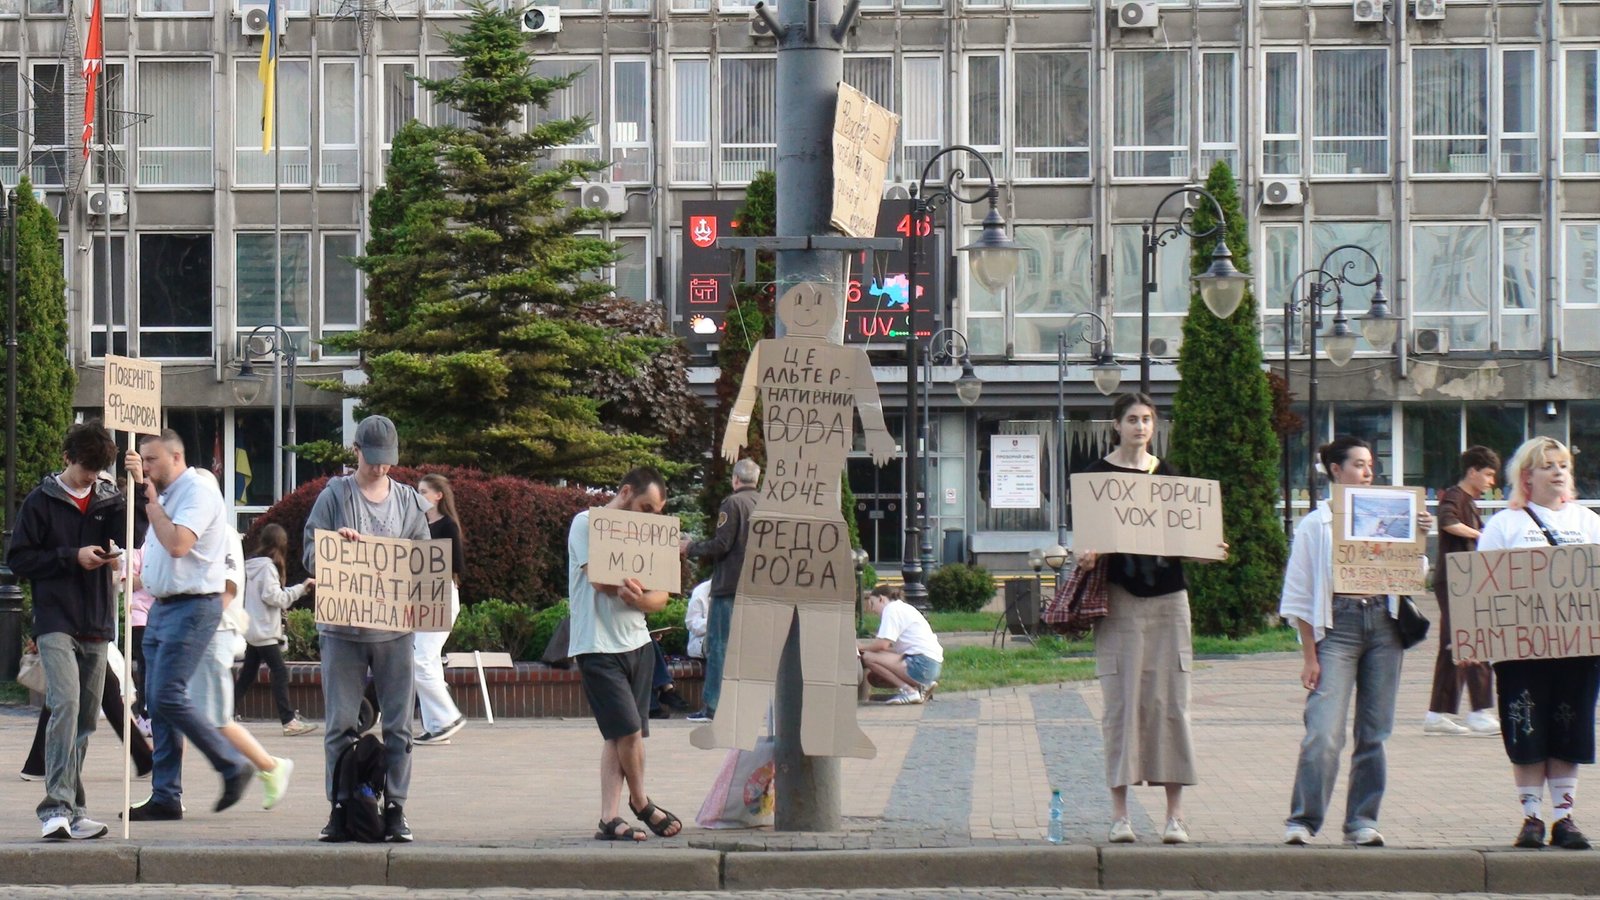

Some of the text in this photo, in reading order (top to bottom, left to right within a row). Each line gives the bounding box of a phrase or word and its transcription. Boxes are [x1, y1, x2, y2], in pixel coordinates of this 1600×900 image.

[695, 289, 714, 300] ЧТ
[863, 317, 893, 336] UV
[784, 347, 816, 367] ЦЕ
[108, 393, 157, 428] ФЕДОРОВА
[768, 405, 844, 448] ВОВА
[776, 459, 818, 480] ВІН
[767, 480, 827, 506] ХОЧЕ
[1089, 479, 1137, 502] VOX
[593, 518, 680, 547] ФЕДОРОВ
[1114, 506, 1158, 528] VOX
[319, 536, 446, 575] ФЕДОРОВ
[752, 519, 840, 560] ФЕДО
[1337, 544, 1356, 564] 50
[318, 567, 446, 601] ДРАПАТИЙ
[751, 554, 838, 591] РОВА
[1450, 553, 1472, 597] У
[316, 595, 446, 629] КОМАНДА МРІЇ
[1473, 593, 1548, 627] НЕМА
[1456, 628, 1506, 659] ВАМ
[1516, 626, 1580, 658] ВОНИ
